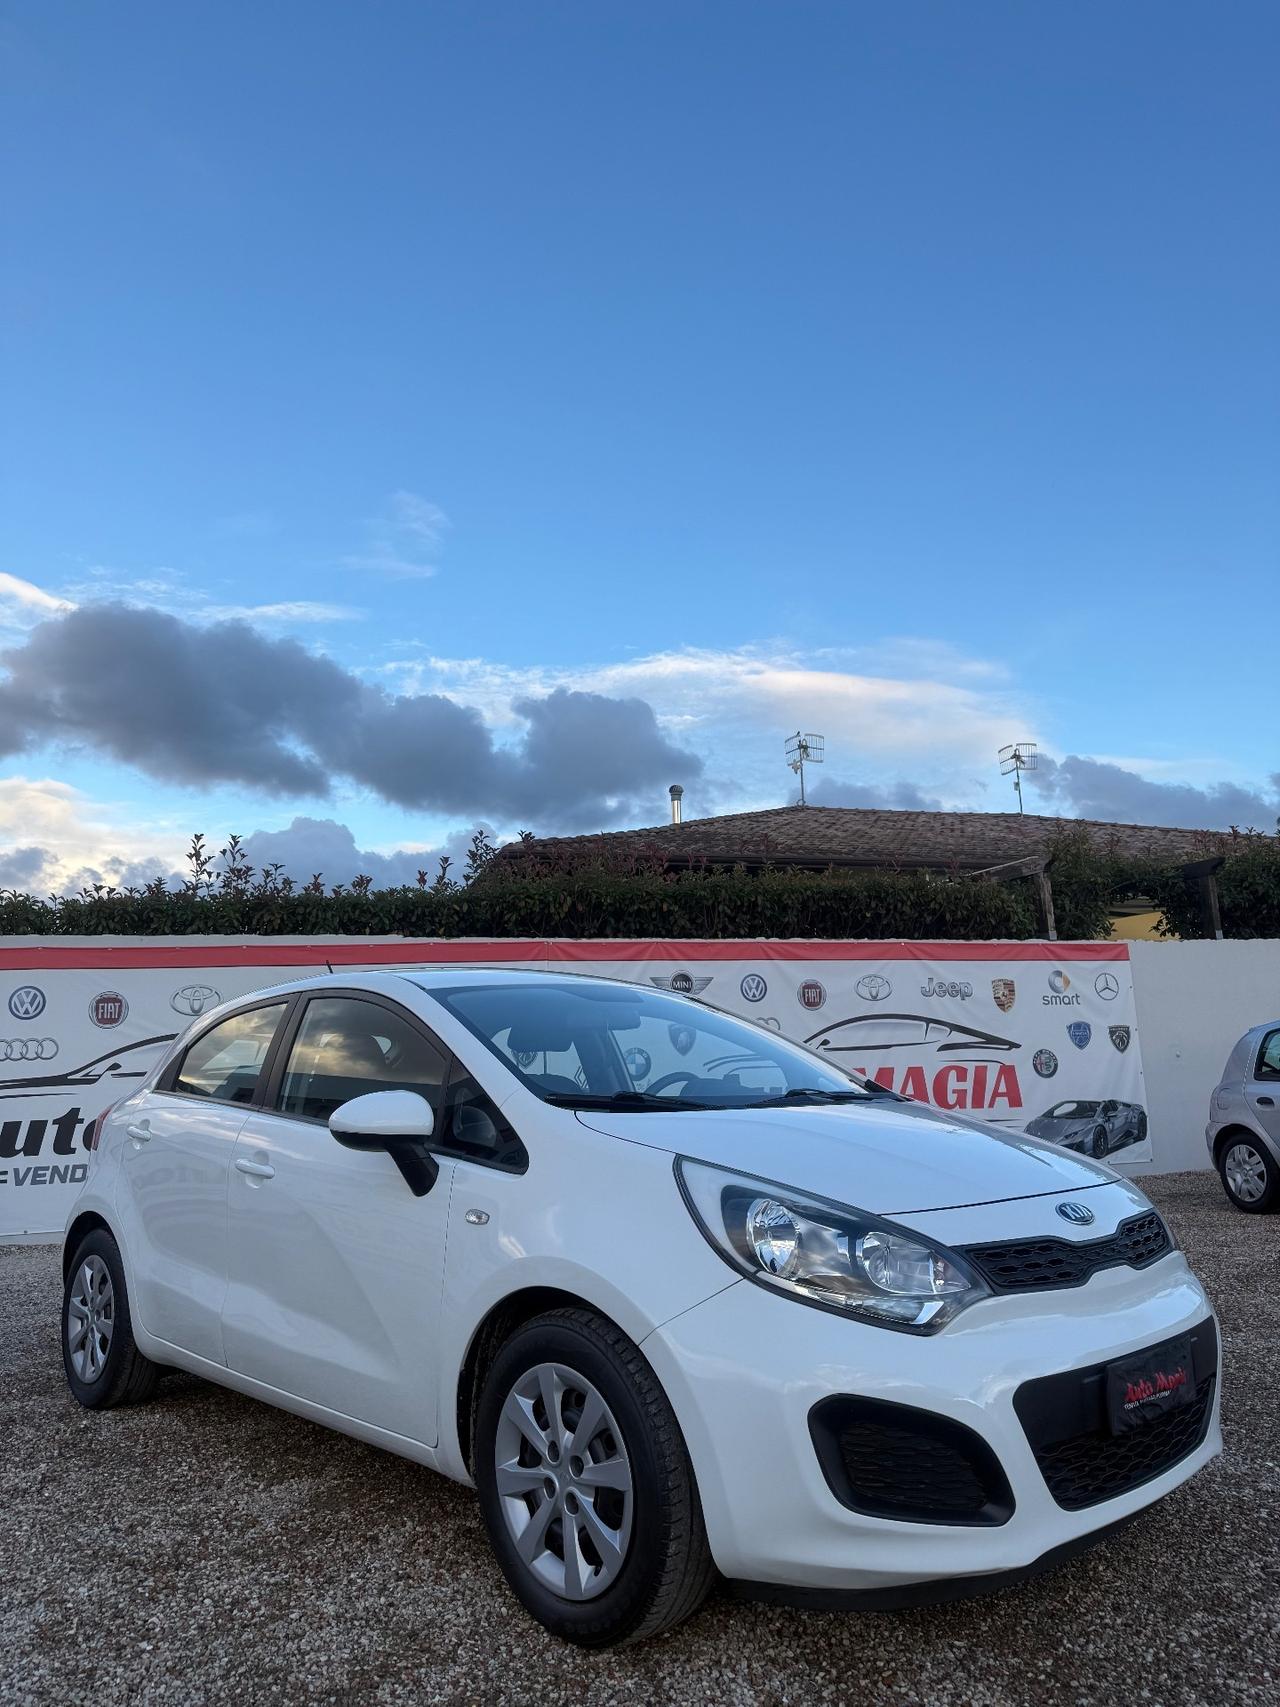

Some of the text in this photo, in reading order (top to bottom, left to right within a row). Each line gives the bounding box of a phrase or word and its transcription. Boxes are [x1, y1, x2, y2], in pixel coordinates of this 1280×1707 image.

[673, 981, 692, 990] MINI
[920, 977, 973, 1000] Jeep
[804, 988, 821, 1003] FIAT
[1042, 992, 1081, 1006] smart
[98, 1002, 121, 1020] FIAT
